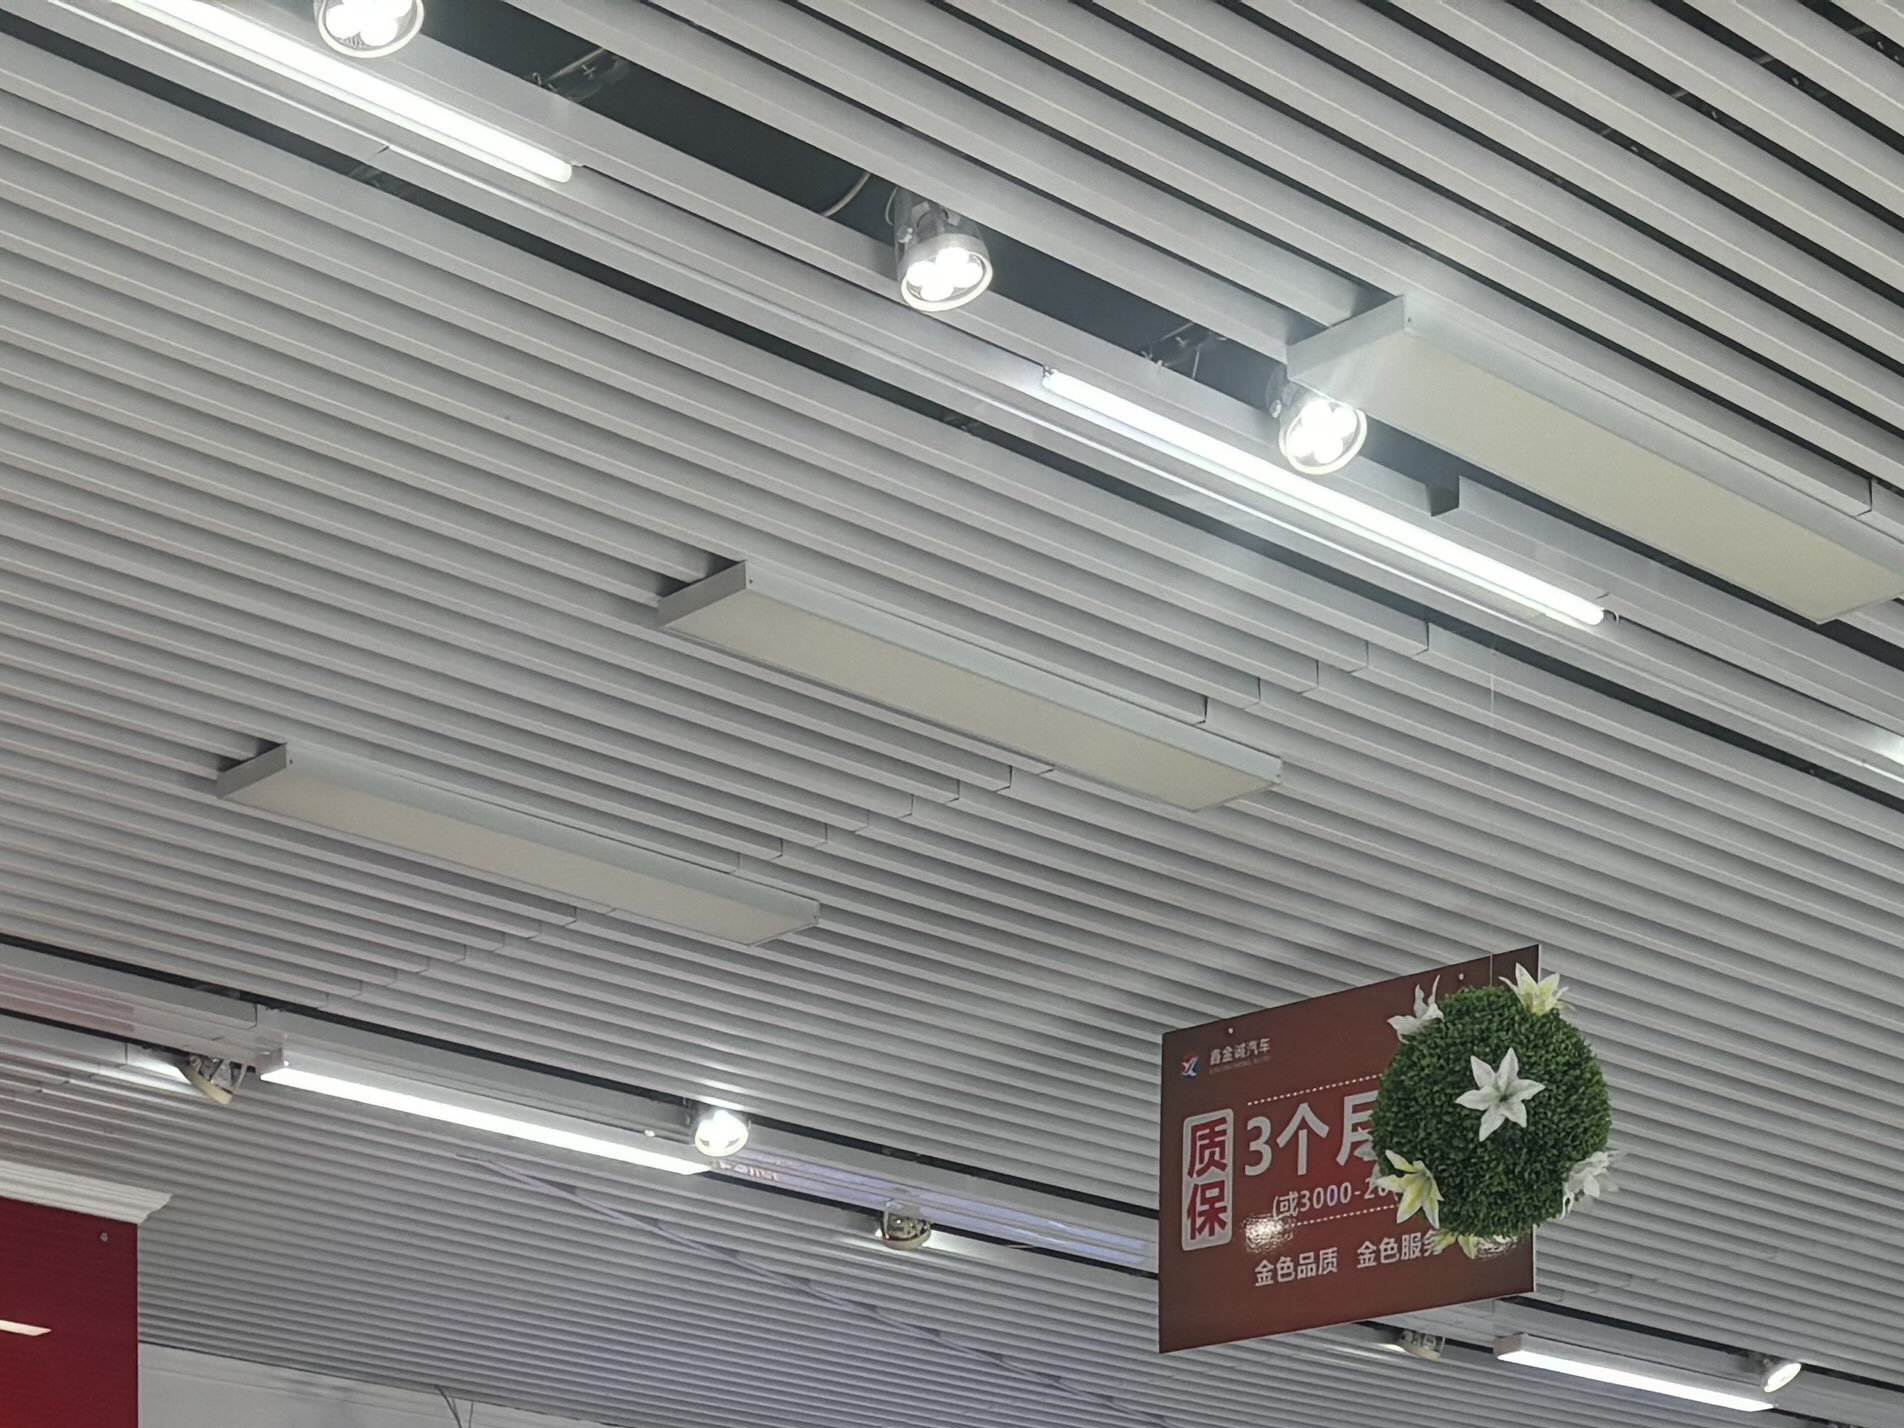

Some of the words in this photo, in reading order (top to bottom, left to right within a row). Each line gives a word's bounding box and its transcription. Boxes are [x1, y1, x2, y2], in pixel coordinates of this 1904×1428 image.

[1186, 1116, 1230, 1240] 质保
[1254, 1247, 1339, 1288] 金色品质
